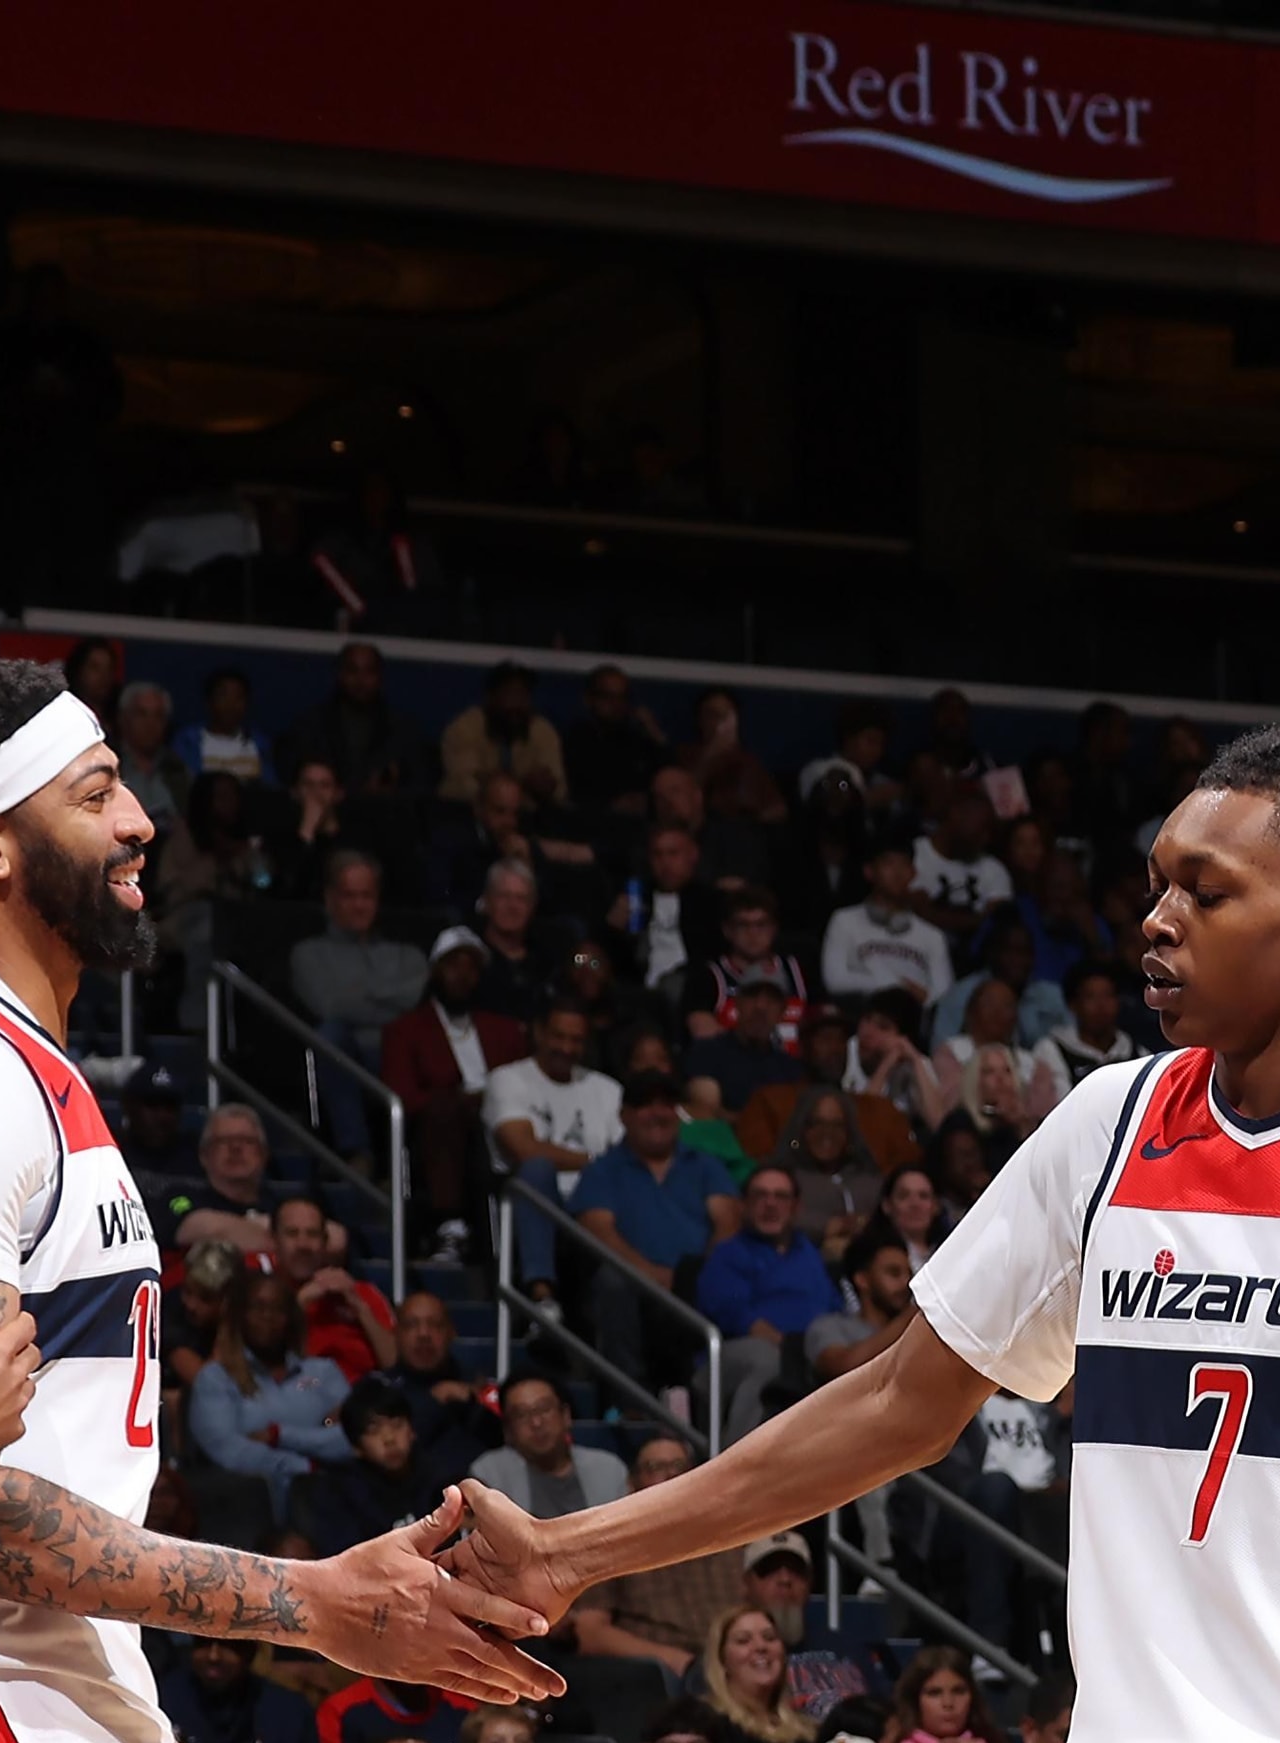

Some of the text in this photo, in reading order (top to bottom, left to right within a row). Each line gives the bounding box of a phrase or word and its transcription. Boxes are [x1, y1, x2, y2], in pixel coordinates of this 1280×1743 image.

[791, 33, 1152, 146] Red River
[1185, 1362, 1253, 1546] 7
